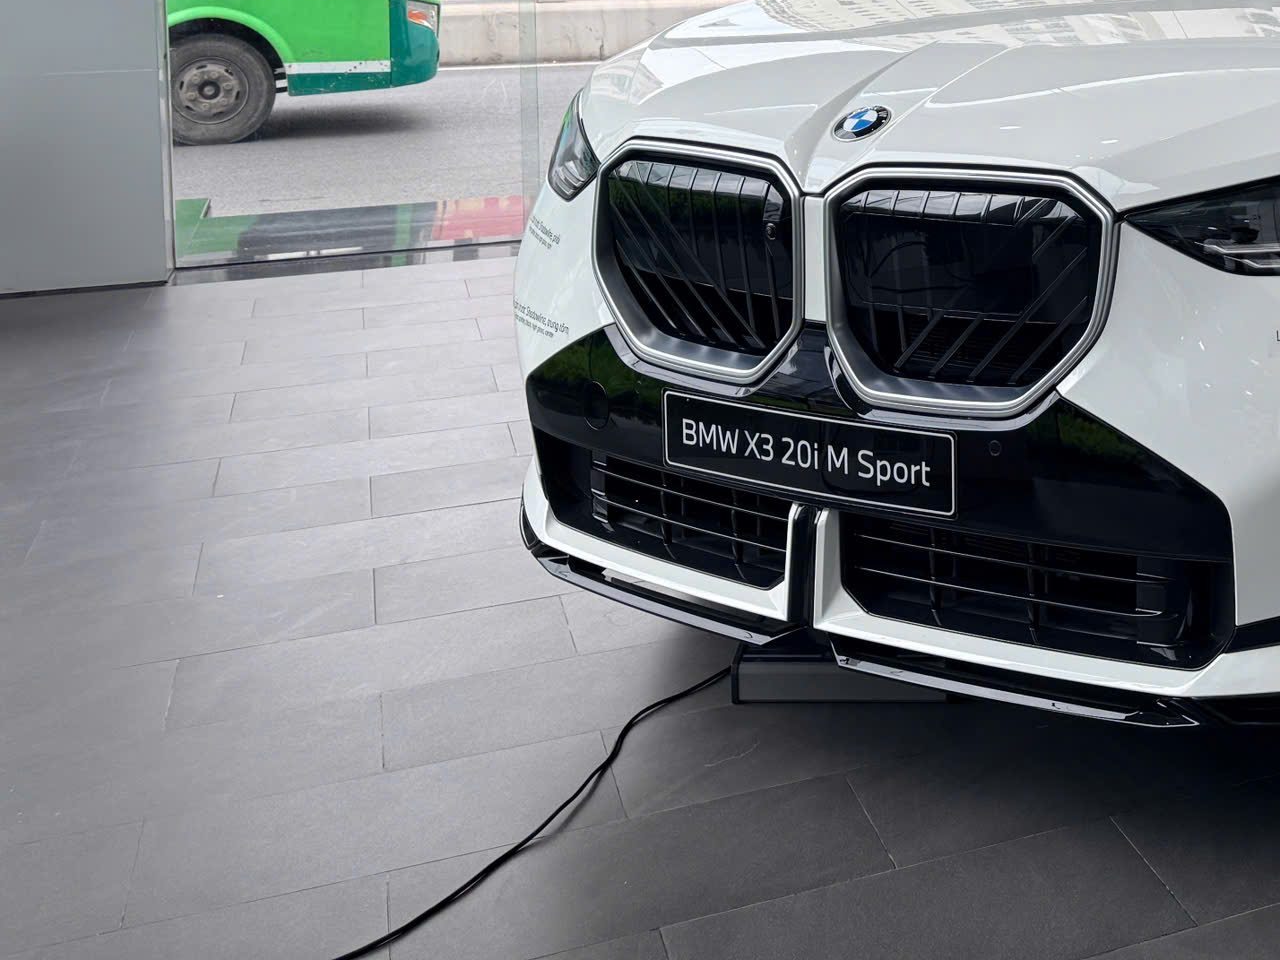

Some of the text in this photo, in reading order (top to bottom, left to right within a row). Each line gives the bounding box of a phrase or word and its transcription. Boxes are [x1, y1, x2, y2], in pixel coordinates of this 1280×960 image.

[682, 418, 931, 487] BMW X3 20i M Sport
